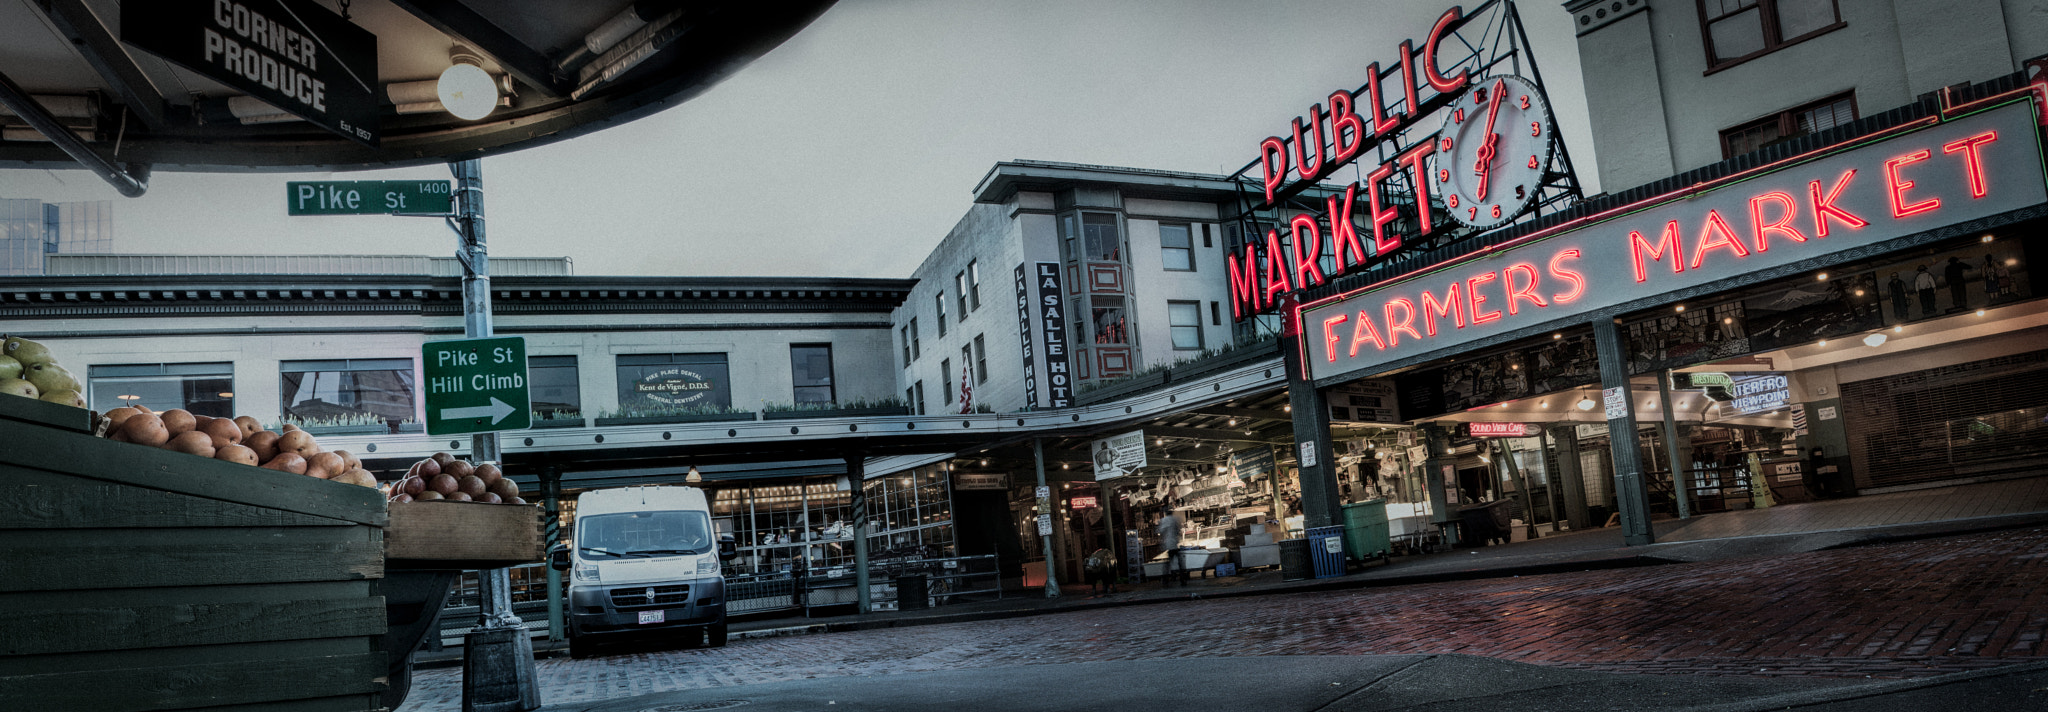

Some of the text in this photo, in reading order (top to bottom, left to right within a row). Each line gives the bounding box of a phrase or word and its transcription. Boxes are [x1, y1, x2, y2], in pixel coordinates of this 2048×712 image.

[213, 0, 317, 72] CORNER
[204, 26, 327, 114] PRODUCE
[1260, 5, 1471, 206] PUBLIC
[1520, 95, 1531, 110] 2
[1454, 108, 1464, 124] 11
[340, 120, 354, 134] Est.
[1532, 121, 1540, 137] 3
[1441, 136, 1453, 152] 10
[1528, 155, 1539, 170] 4
[1440, 169, 1449, 183] 9
[298, 182, 448, 210] Pike St 1400
[1515, 184, 1525, 200] 5
[1449, 193, 1459, 208] 8
[1468, 206, 1477, 221] 7
[1491, 204, 1501, 219] 6
[1227, 135, 1438, 323] MARKET
[1324, 130, 1999, 363] FARMERS MARKET
[1016, 269, 1025, 294] LA
[1041, 265, 1057, 289] LA
[1018, 295, 1031, 359] SALLE
[1044, 295, 1063, 356] SALLE
[438, 347, 514, 367] Pike St
[432, 372, 523, 393] Hill Climb
[646, 372, 659, 382] PIKE
[681, 370, 703, 381] DENTAL
[647, 392, 704, 404] GENERAL DENTISTRY
[1470, 422, 1491, 432] SOUND
[1492, 422, 1508, 432] VIEW
